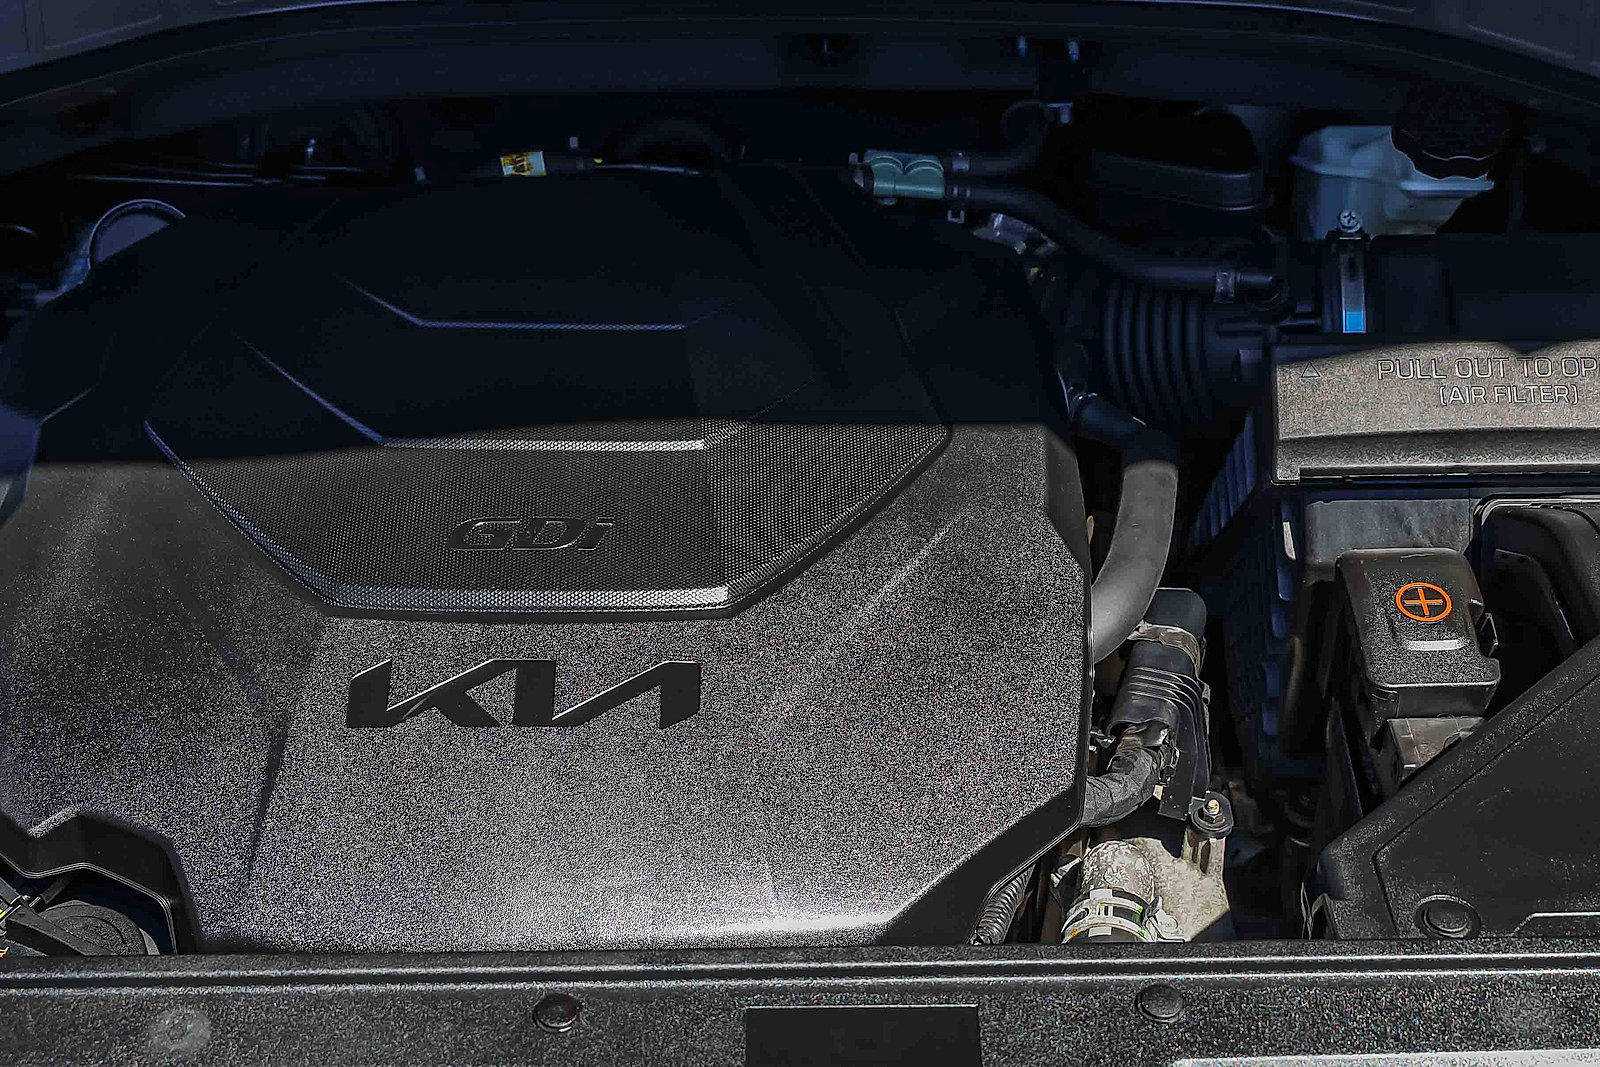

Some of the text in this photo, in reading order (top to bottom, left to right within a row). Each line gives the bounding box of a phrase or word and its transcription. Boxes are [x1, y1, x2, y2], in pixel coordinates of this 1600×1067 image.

[1377, 356, 1600, 380] PULL OUT TO OP
[346, 658, 701, 730] KIA
